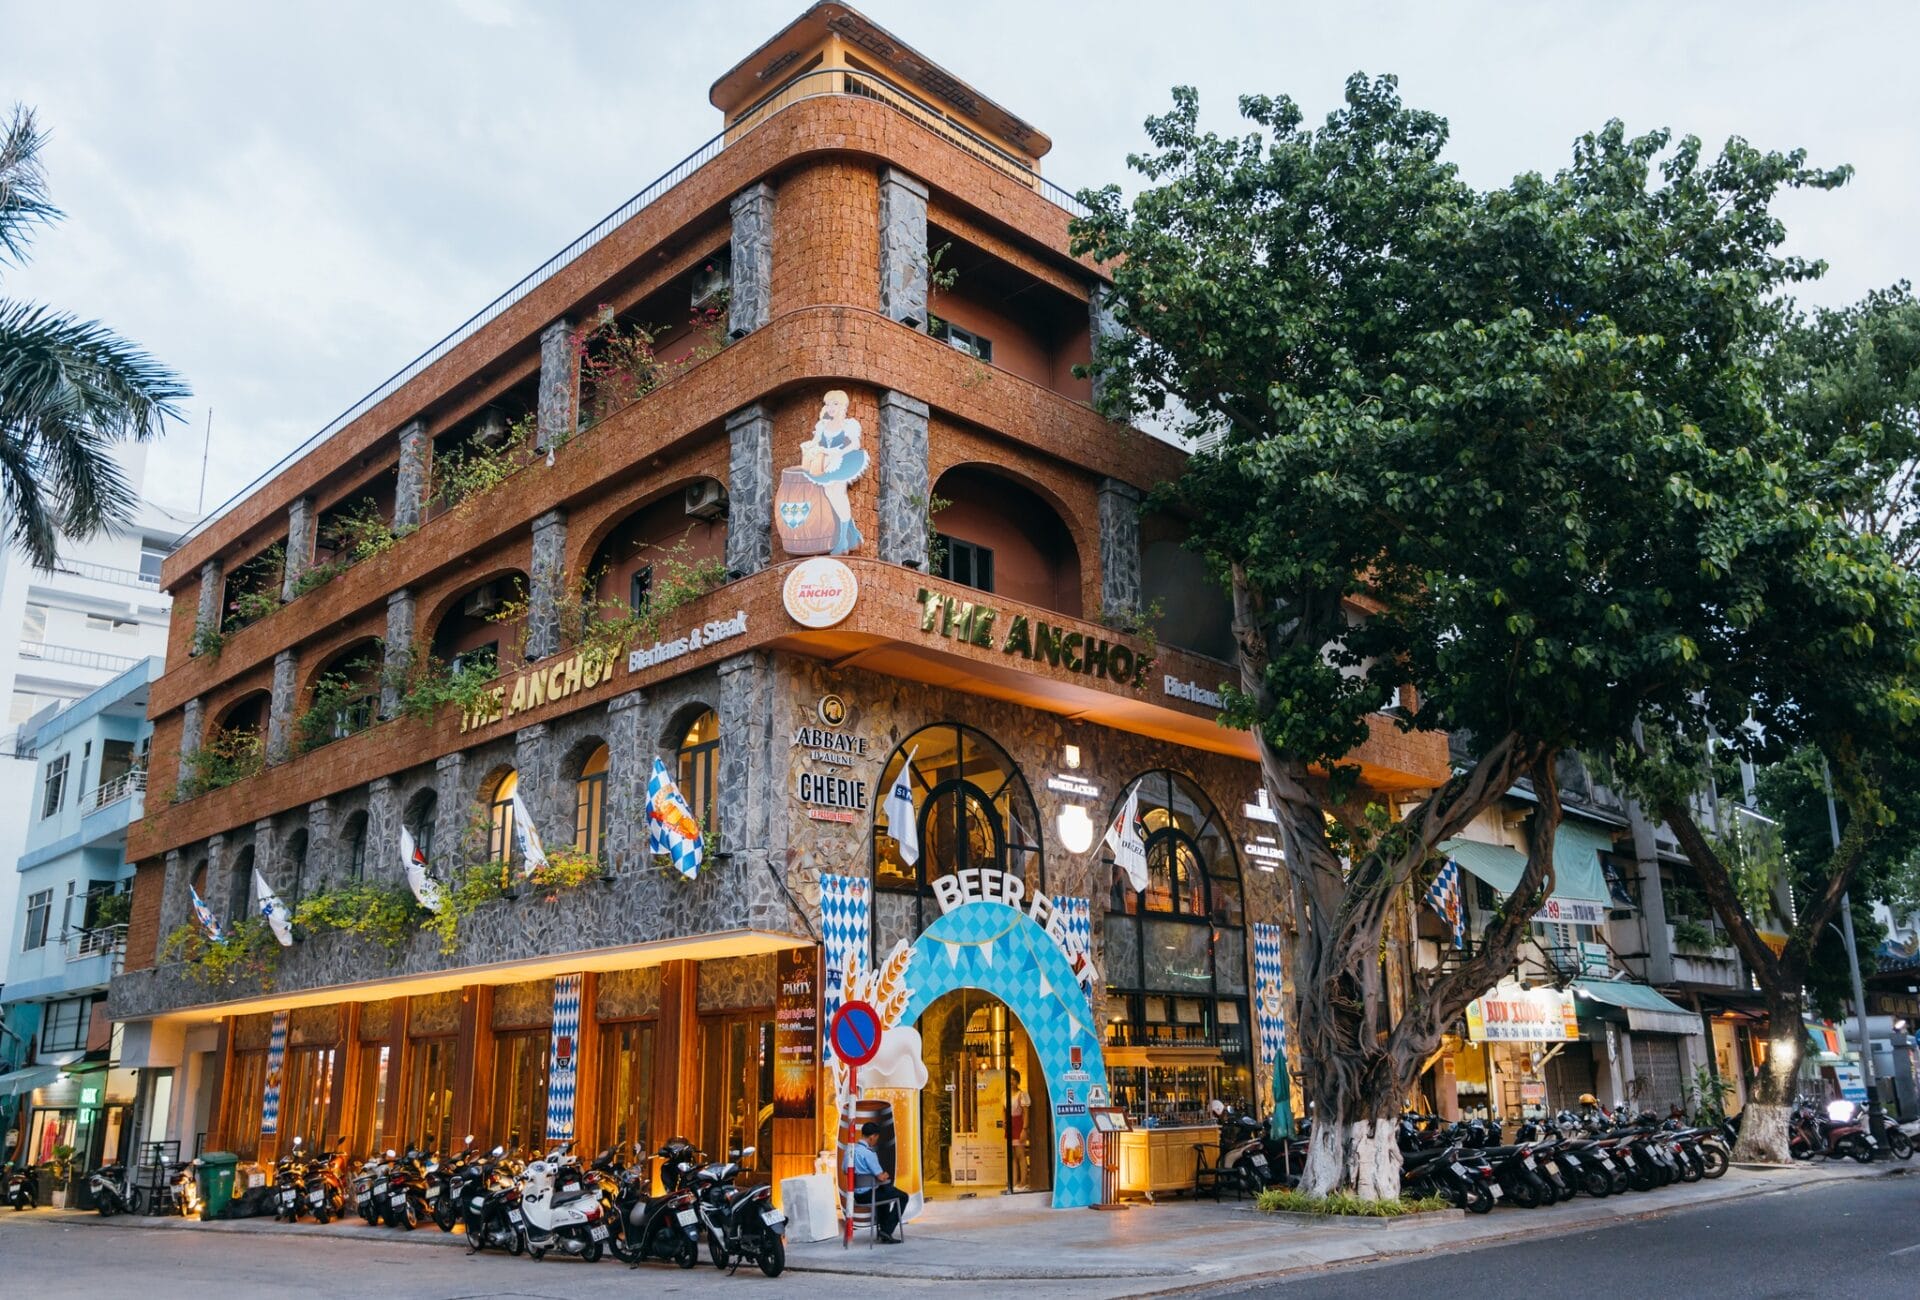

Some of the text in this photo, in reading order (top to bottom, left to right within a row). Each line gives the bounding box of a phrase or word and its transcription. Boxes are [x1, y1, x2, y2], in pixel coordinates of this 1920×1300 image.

[916, 587, 996, 649] THE
[628, 610, 749, 673] Bierhaus & Steak
[1163, 674, 1223, 709] Bierhaus
[797, 727, 868, 756] ABBAYE
[799, 767, 868, 811] CHÉRIE
[931, 868, 1100, 984] BEER FEST
[1547, 900, 1560, 919] 89
[783, 980, 812, 996] PARTY
